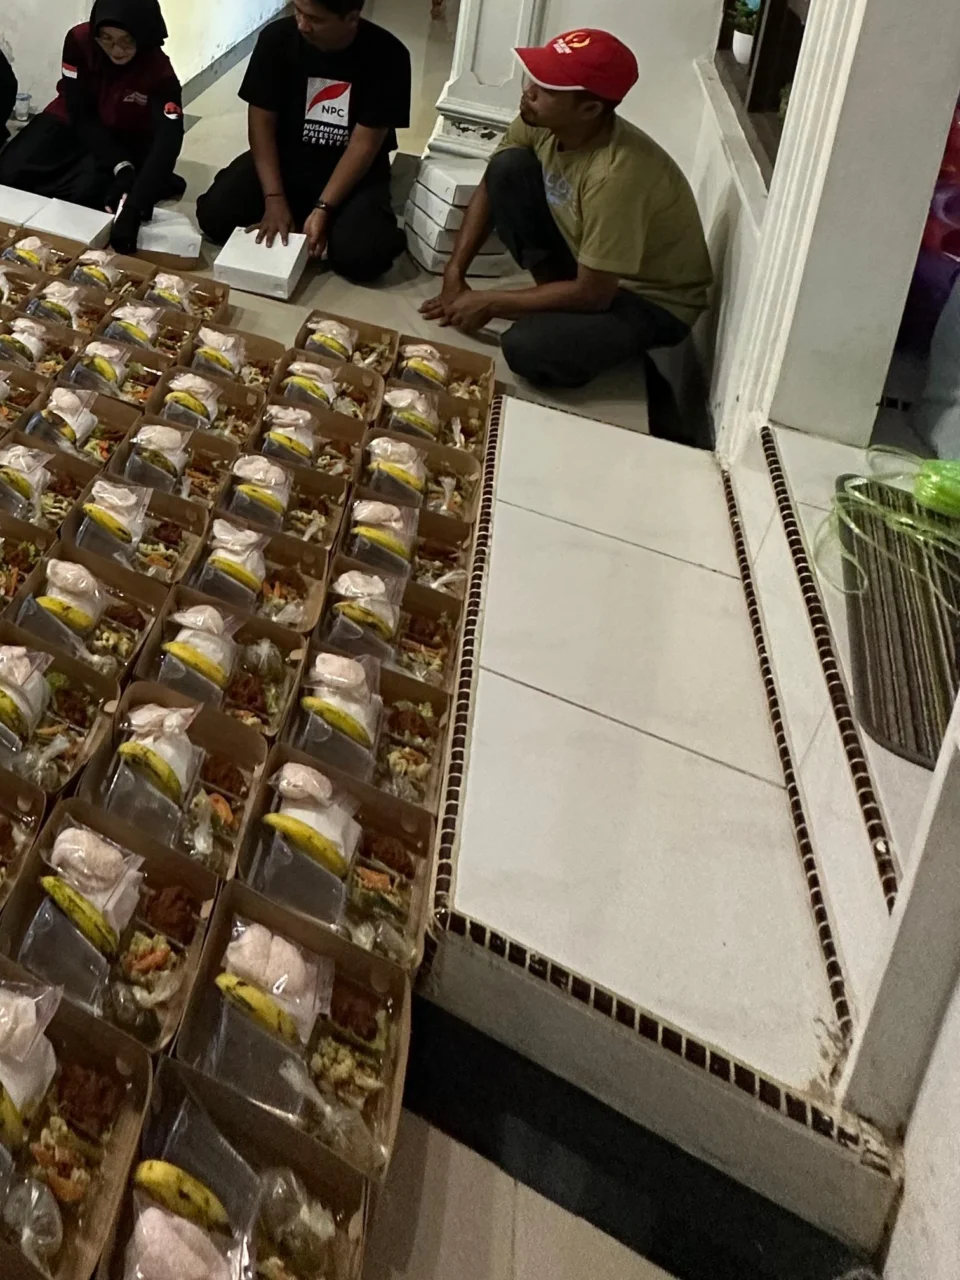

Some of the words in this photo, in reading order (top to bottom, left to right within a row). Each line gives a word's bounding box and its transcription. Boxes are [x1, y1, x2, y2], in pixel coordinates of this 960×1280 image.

[321, 105, 345, 117] NPC
[302, 129, 349, 141] PALESTINA
[303, 123, 349, 135] NUSANTARA
